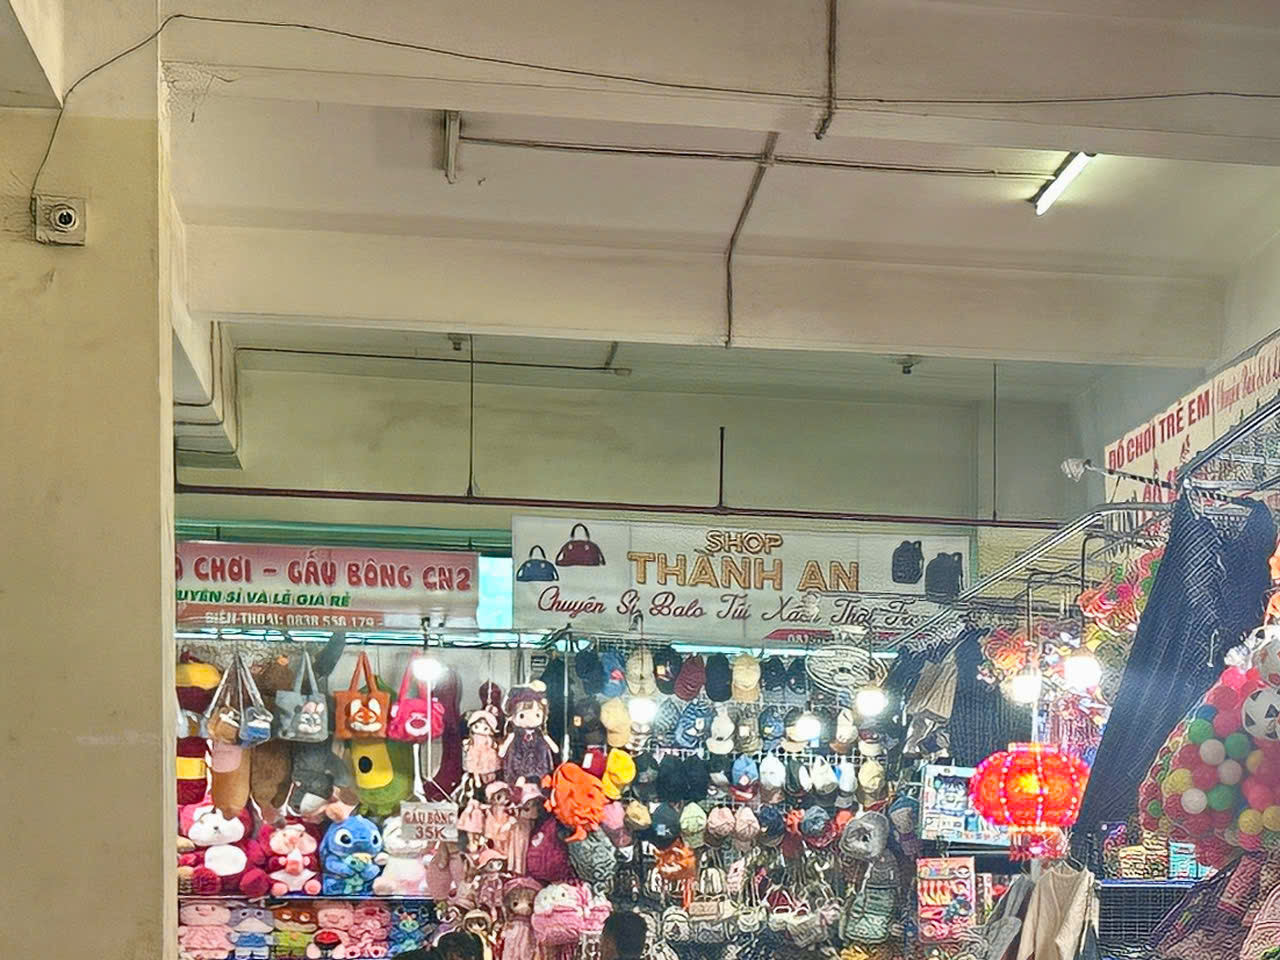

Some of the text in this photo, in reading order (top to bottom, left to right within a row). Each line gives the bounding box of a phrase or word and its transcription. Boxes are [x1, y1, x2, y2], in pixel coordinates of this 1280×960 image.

[1188, 389, 1210, 426] EM
[706, 529, 783, 554] SHOP
[193, 555, 251, 584] CHƠI
[287, 547, 338, 587] GẤU
[347, 557, 413, 589] BÔNG
[422, 564, 472, 592] CN2
[627, 548, 860, 593] THÀNH AN
[538, 585, 607, 618] Chuyên
[650, 590, 707, 619] Balo
